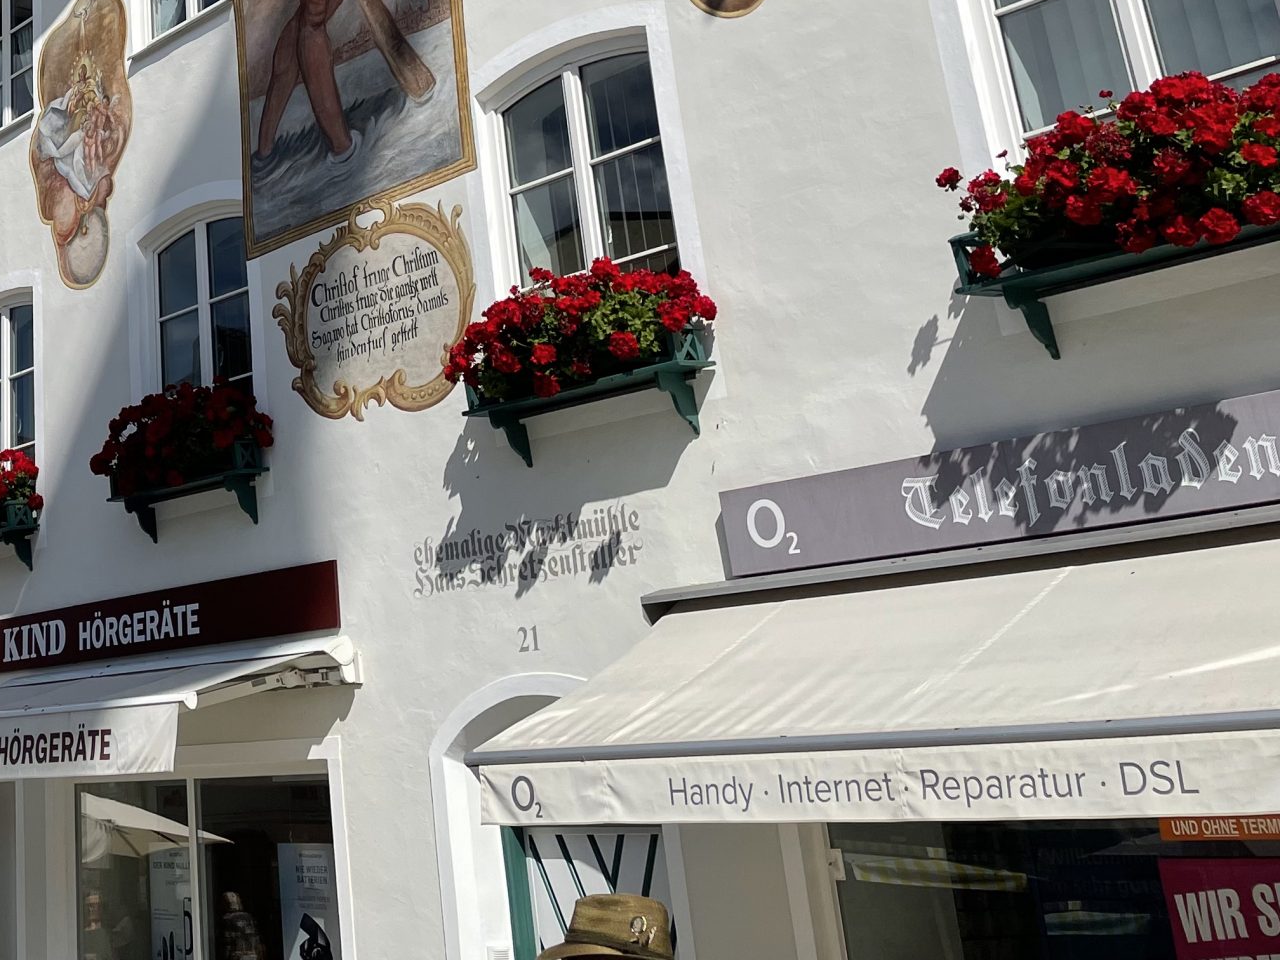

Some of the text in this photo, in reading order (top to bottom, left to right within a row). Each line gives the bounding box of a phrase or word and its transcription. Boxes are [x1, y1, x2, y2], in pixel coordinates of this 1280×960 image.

[901, 428, 1280, 530] Telefonladen
[3, 600, 200, 662] KIND HÖRGERÄTE
[517, 625, 540, 652] 21
[668, 775, 753, 812] Handy
[777, 772, 896, 803] Internet
[919, 768, 1086, 808] Reparatur
[1119, 759, 1200, 796] DSL
[1171, 820, 1199, 835] UND
[1201, 819, 1239, 837] OHNE
[1173, 888, 1249, 943] WIR
